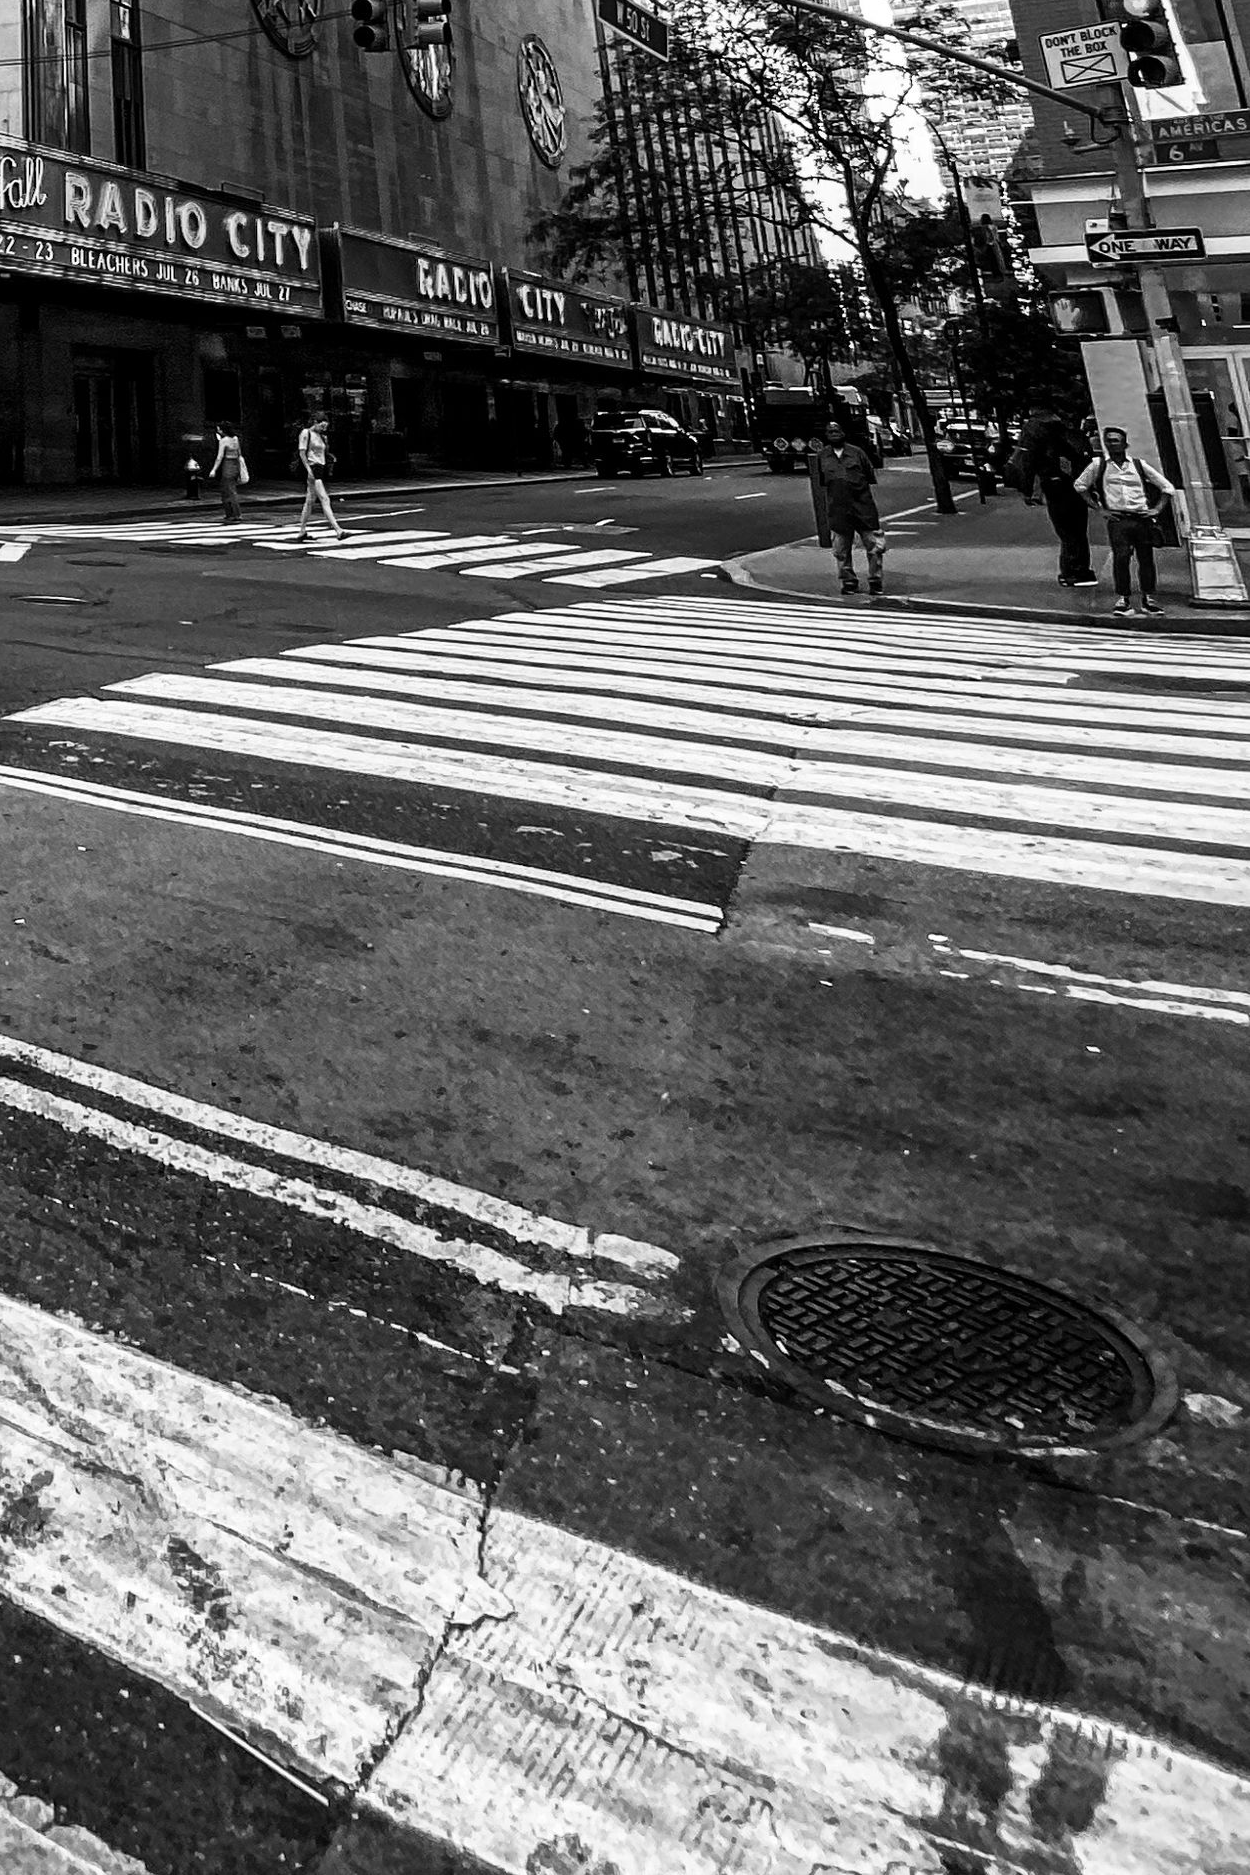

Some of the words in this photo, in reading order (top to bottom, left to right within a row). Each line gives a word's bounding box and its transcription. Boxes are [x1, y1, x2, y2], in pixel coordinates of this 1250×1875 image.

[626, 7, 639, 33] 50
[1045, 33, 1076, 49] DON'T
[1080, 26, 1117, 41] BLOCK
[1060, 44, 1081, 58] THE
[1085, 40, 1108, 54] BOX
[1158, 118, 1248, 138] AMERICAS
[1169, 145, 1185, 161] 6
[64, 171, 207, 249] RADIO
[221, 209, 312, 270] CITY
[1100, 240, 1136, 254] ONE
[1154, 237, 1192, 251] WAY
[35, 241, 54, 261] 23
[71, 246, 149, 277] BLEACHERS
[156, 263, 178, 283] JUL
[185, 268, 200, 286] 26
[212, 273, 248, 294] BANKS
[254, 282, 272, 299] JUL
[278, 285, 291, 301] 27
[417, 257, 493, 309] RADIO
[516, 284, 565, 325] CITY
